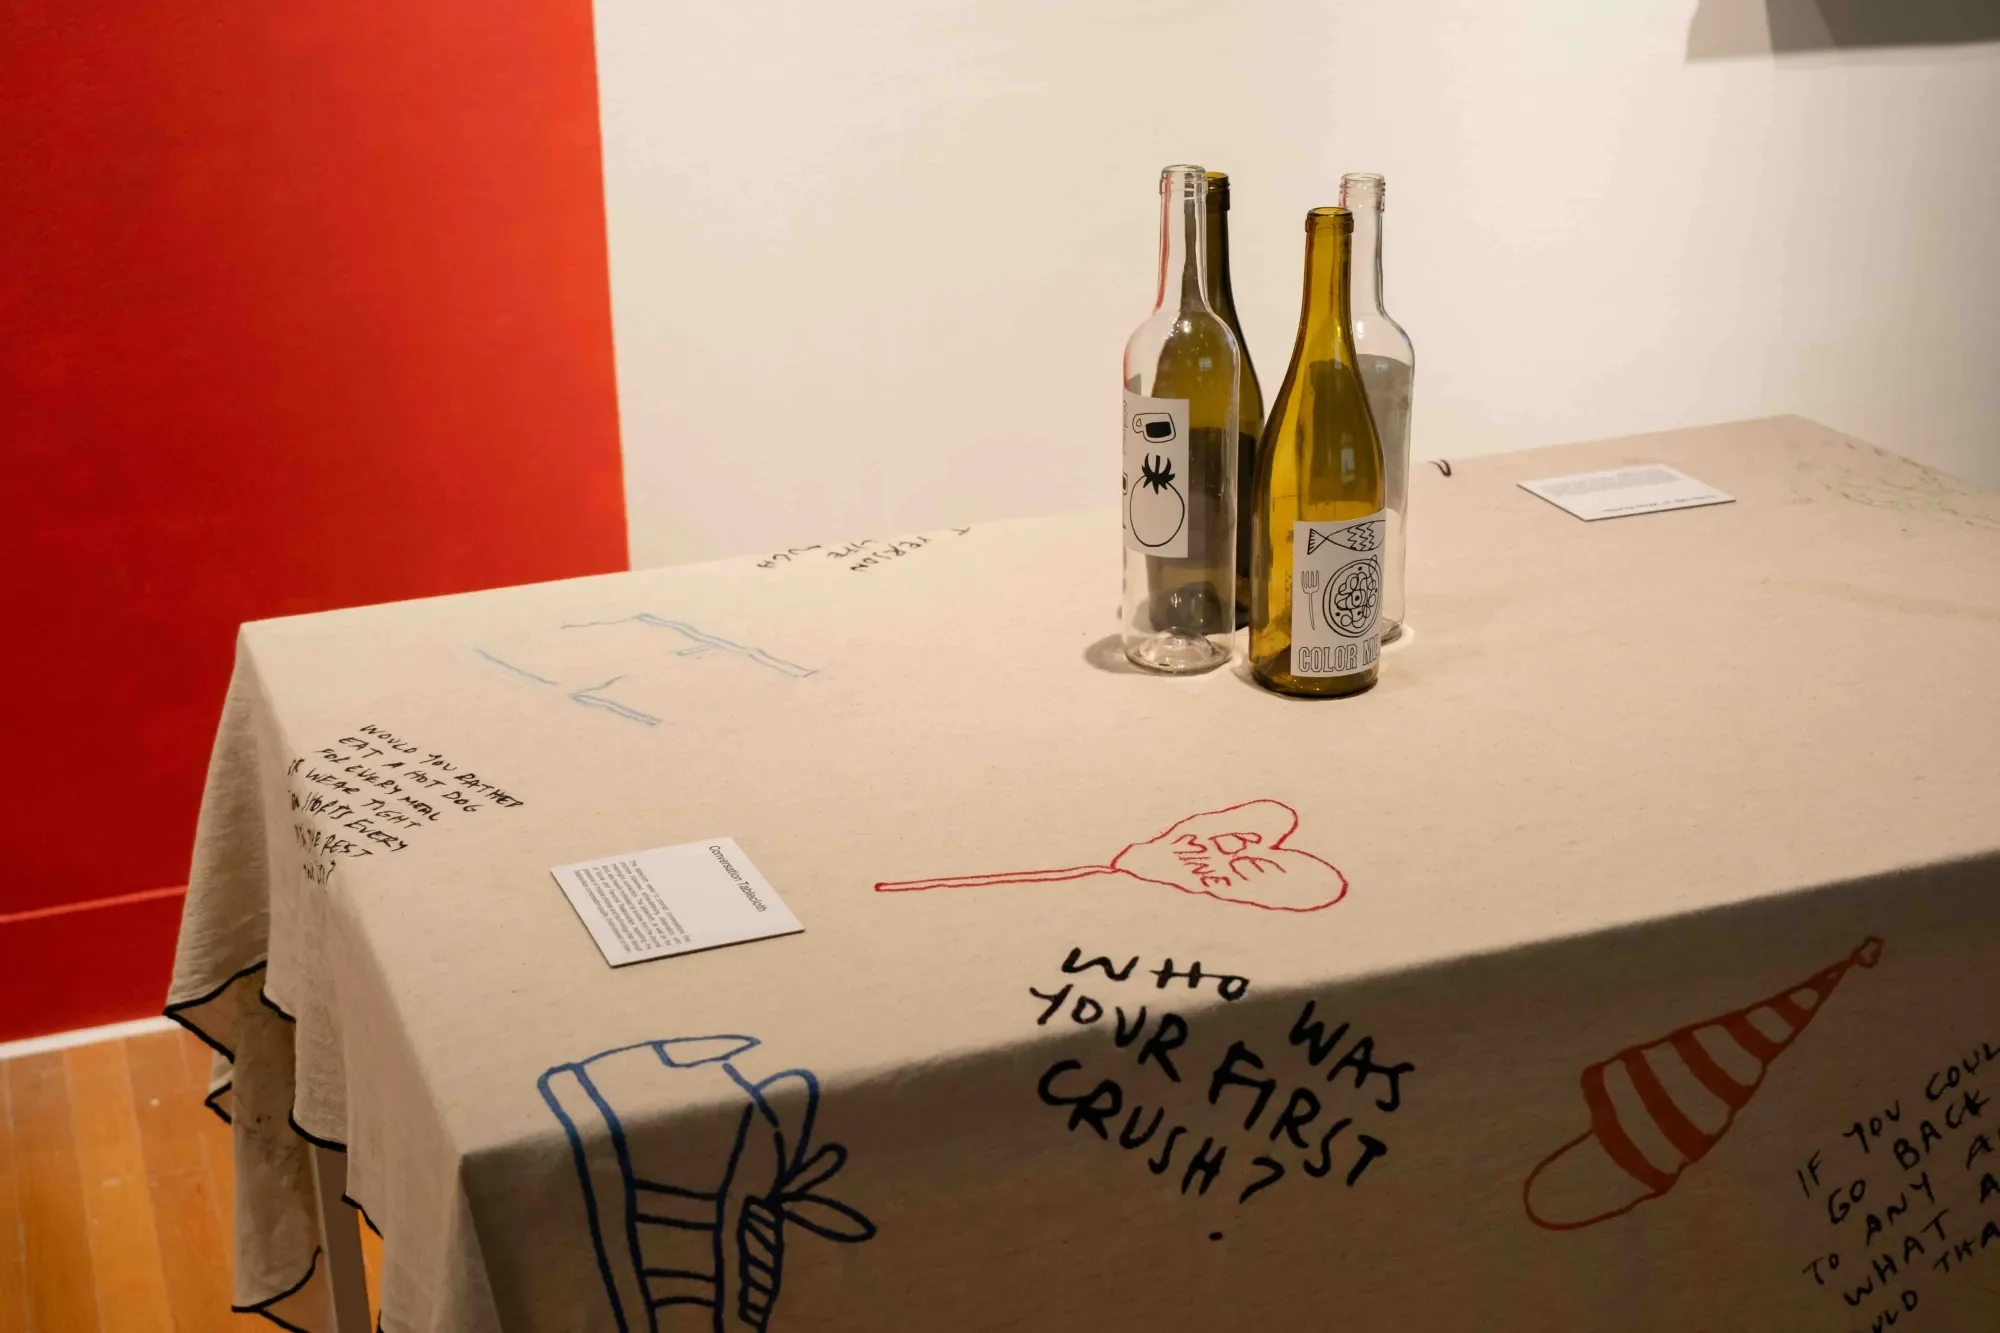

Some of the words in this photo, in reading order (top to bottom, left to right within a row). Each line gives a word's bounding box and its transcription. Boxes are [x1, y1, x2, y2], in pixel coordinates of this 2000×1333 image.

[1298, 643, 1358, 673] COLOR
[305, 767, 361, 796] WEAR
[360, 797, 424, 830] TIGHT
[338, 736, 384, 759] EAT
[403, 770, 447, 790] HOT
[441, 790, 485, 814] DOG
[344, 764, 403, 796] EVERY
[399, 795, 441, 823] MEAL
[359, 723, 419, 755] WOULD
[419, 752, 459, 773] YOU
[453, 772, 525, 809] RATHER
[320, 833, 374, 859] REST
[343, 818, 410, 853] EVERY
[1170, 832, 1232, 888] MINE
[1208, 831, 1287, 882] BE
[708, 844, 743, 883] Conversation
[738, 880, 769, 914] Tablecloth
[1061, 946, 1251, 1002] WHO
[1288, 999, 1416, 1113] WAS
[1029, 983, 1190, 1084] YOUR
[1208, 1040, 1389, 1187] FIRST
[1796, 1149, 1822, 1199] IF
[1842, 1099, 1901, 1155] YOU
[1827, 1178, 1867, 1226] GO
[1893, 1089, 1992, 1172] BACK
[1801, 1252, 1841, 1286] TO
[1865, 1171, 1936, 1247] ANY
[1843, 1208, 1950, 1307] WHAT
